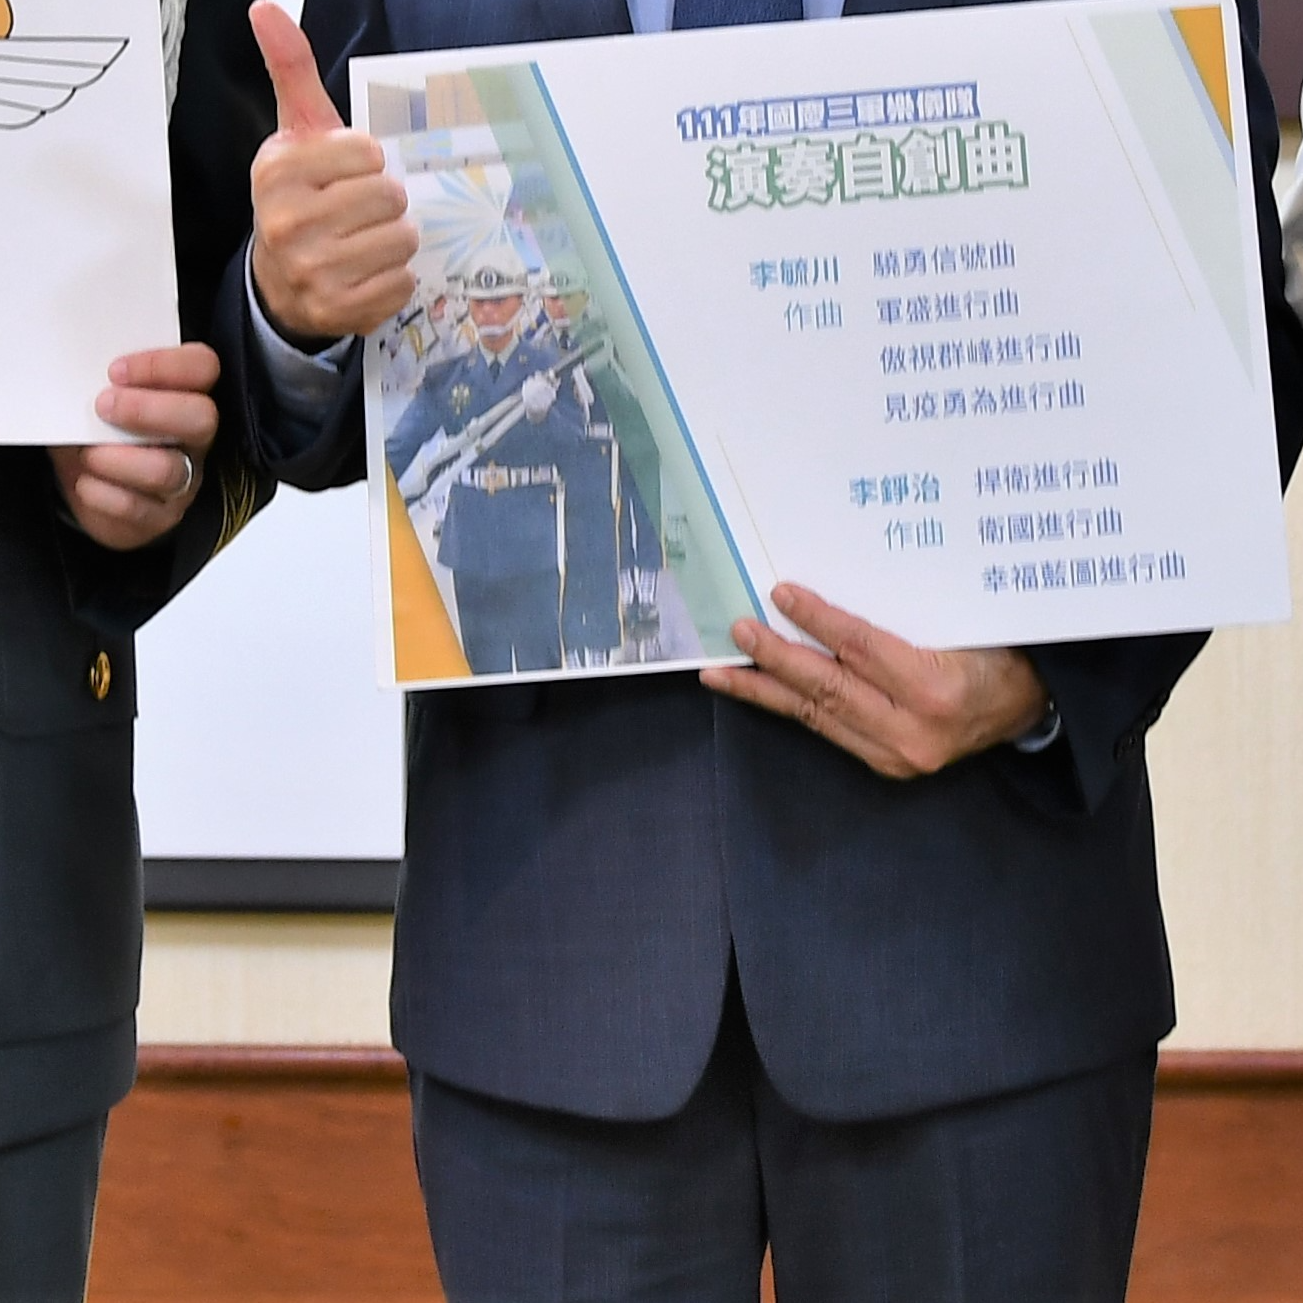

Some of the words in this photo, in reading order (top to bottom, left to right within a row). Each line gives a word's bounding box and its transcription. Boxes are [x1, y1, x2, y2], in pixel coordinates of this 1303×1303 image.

[706, 120, 1029, 211] 演奏自創曲
[783, 298, 843, 332] 作曲
[876, 288, 1019, 326] 軍盛進行曲
[880, 331, 1082, 375] 傲視群峰進行曲
[884, 517, 944, 551] 作曲
[978, 506, 1123, 546] 衛國進行曲
[982, 550, 1186, 595] 幸福藍圖進行曲
